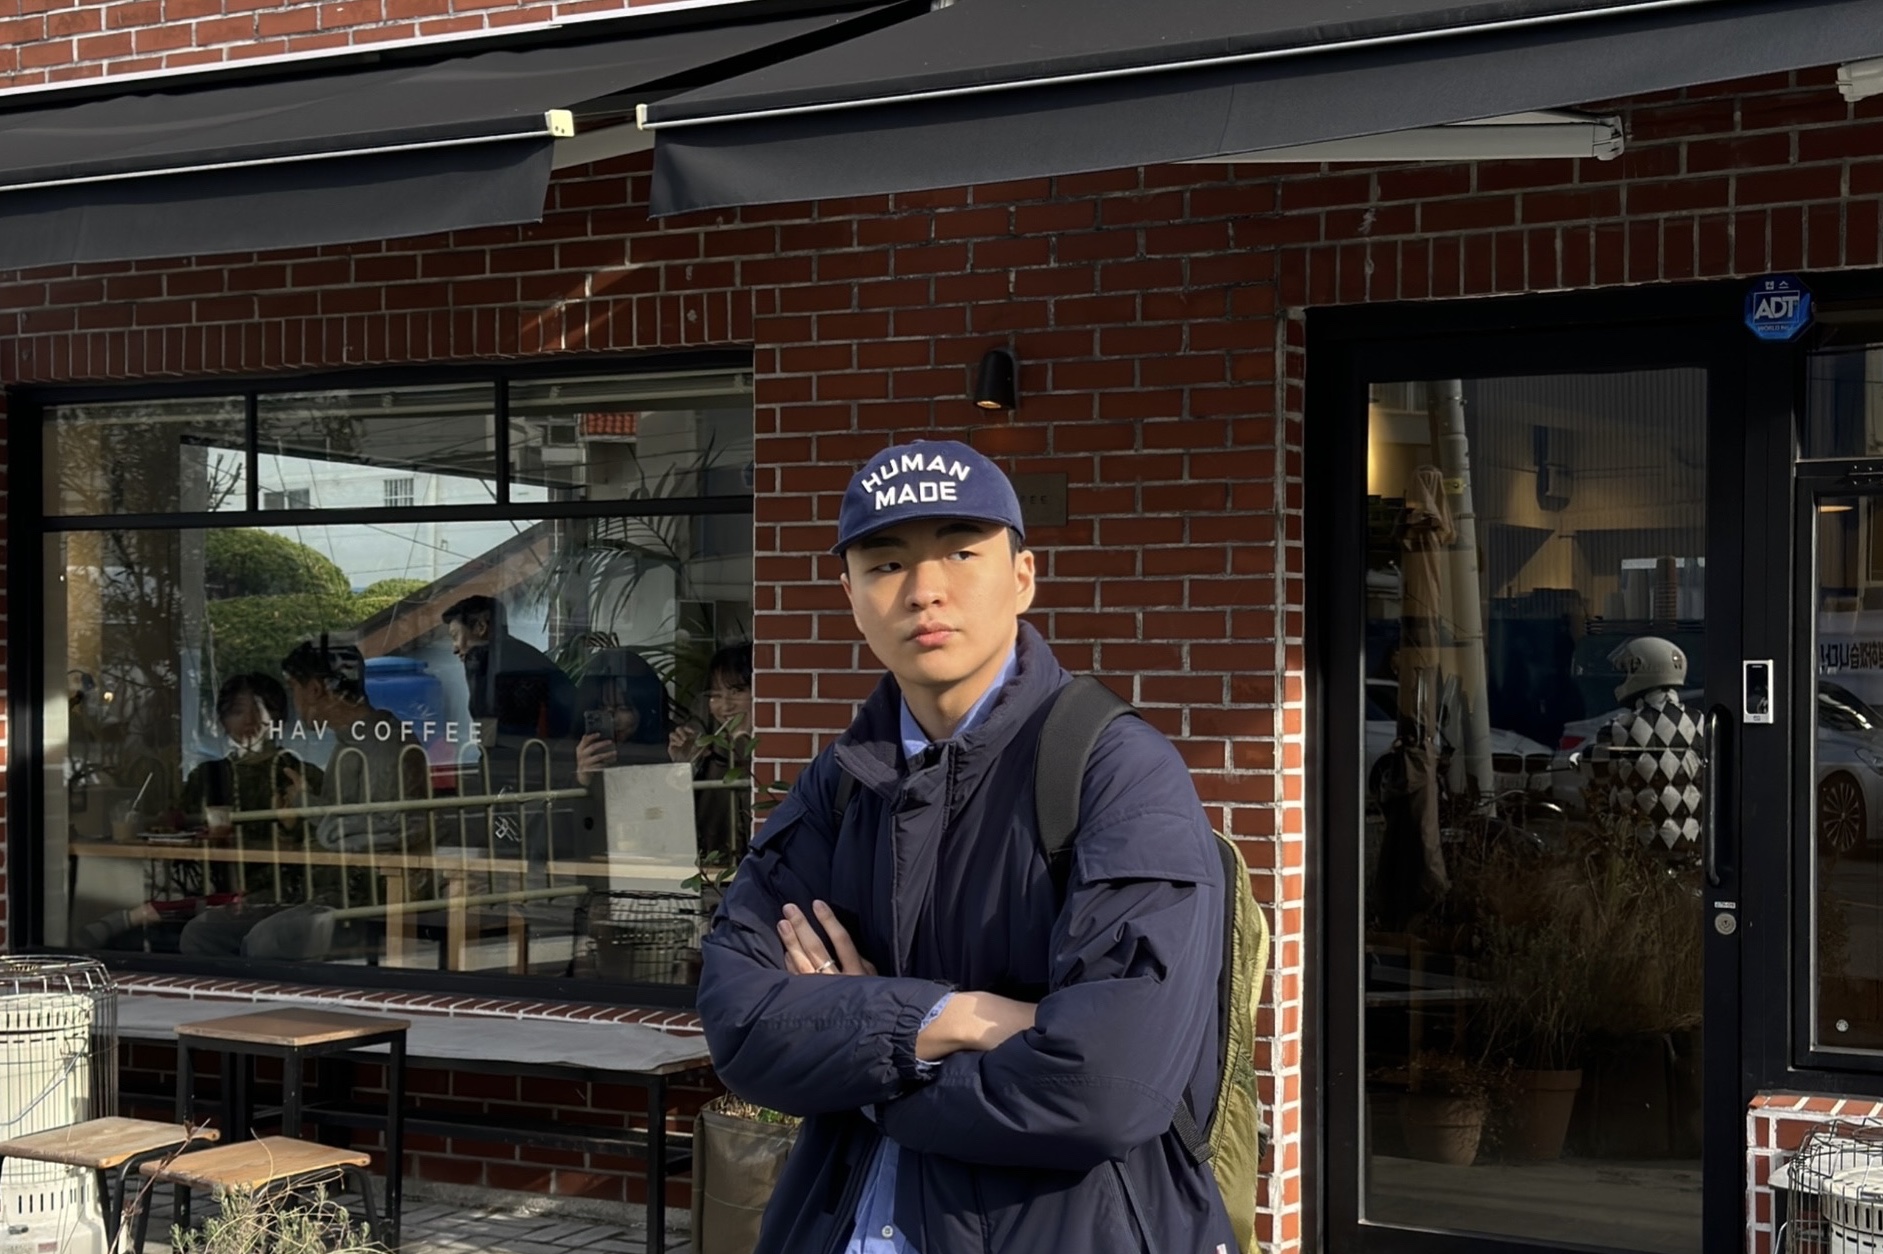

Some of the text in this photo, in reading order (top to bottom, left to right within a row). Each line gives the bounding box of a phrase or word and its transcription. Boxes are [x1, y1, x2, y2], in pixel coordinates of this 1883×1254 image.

[1754, 295, 1799, 320] ADT
[861, 453, 971, 494] HUMAN
[875, 481, 958, 511] MADE
[269, 719, 482, 743] HAV COFFEE
